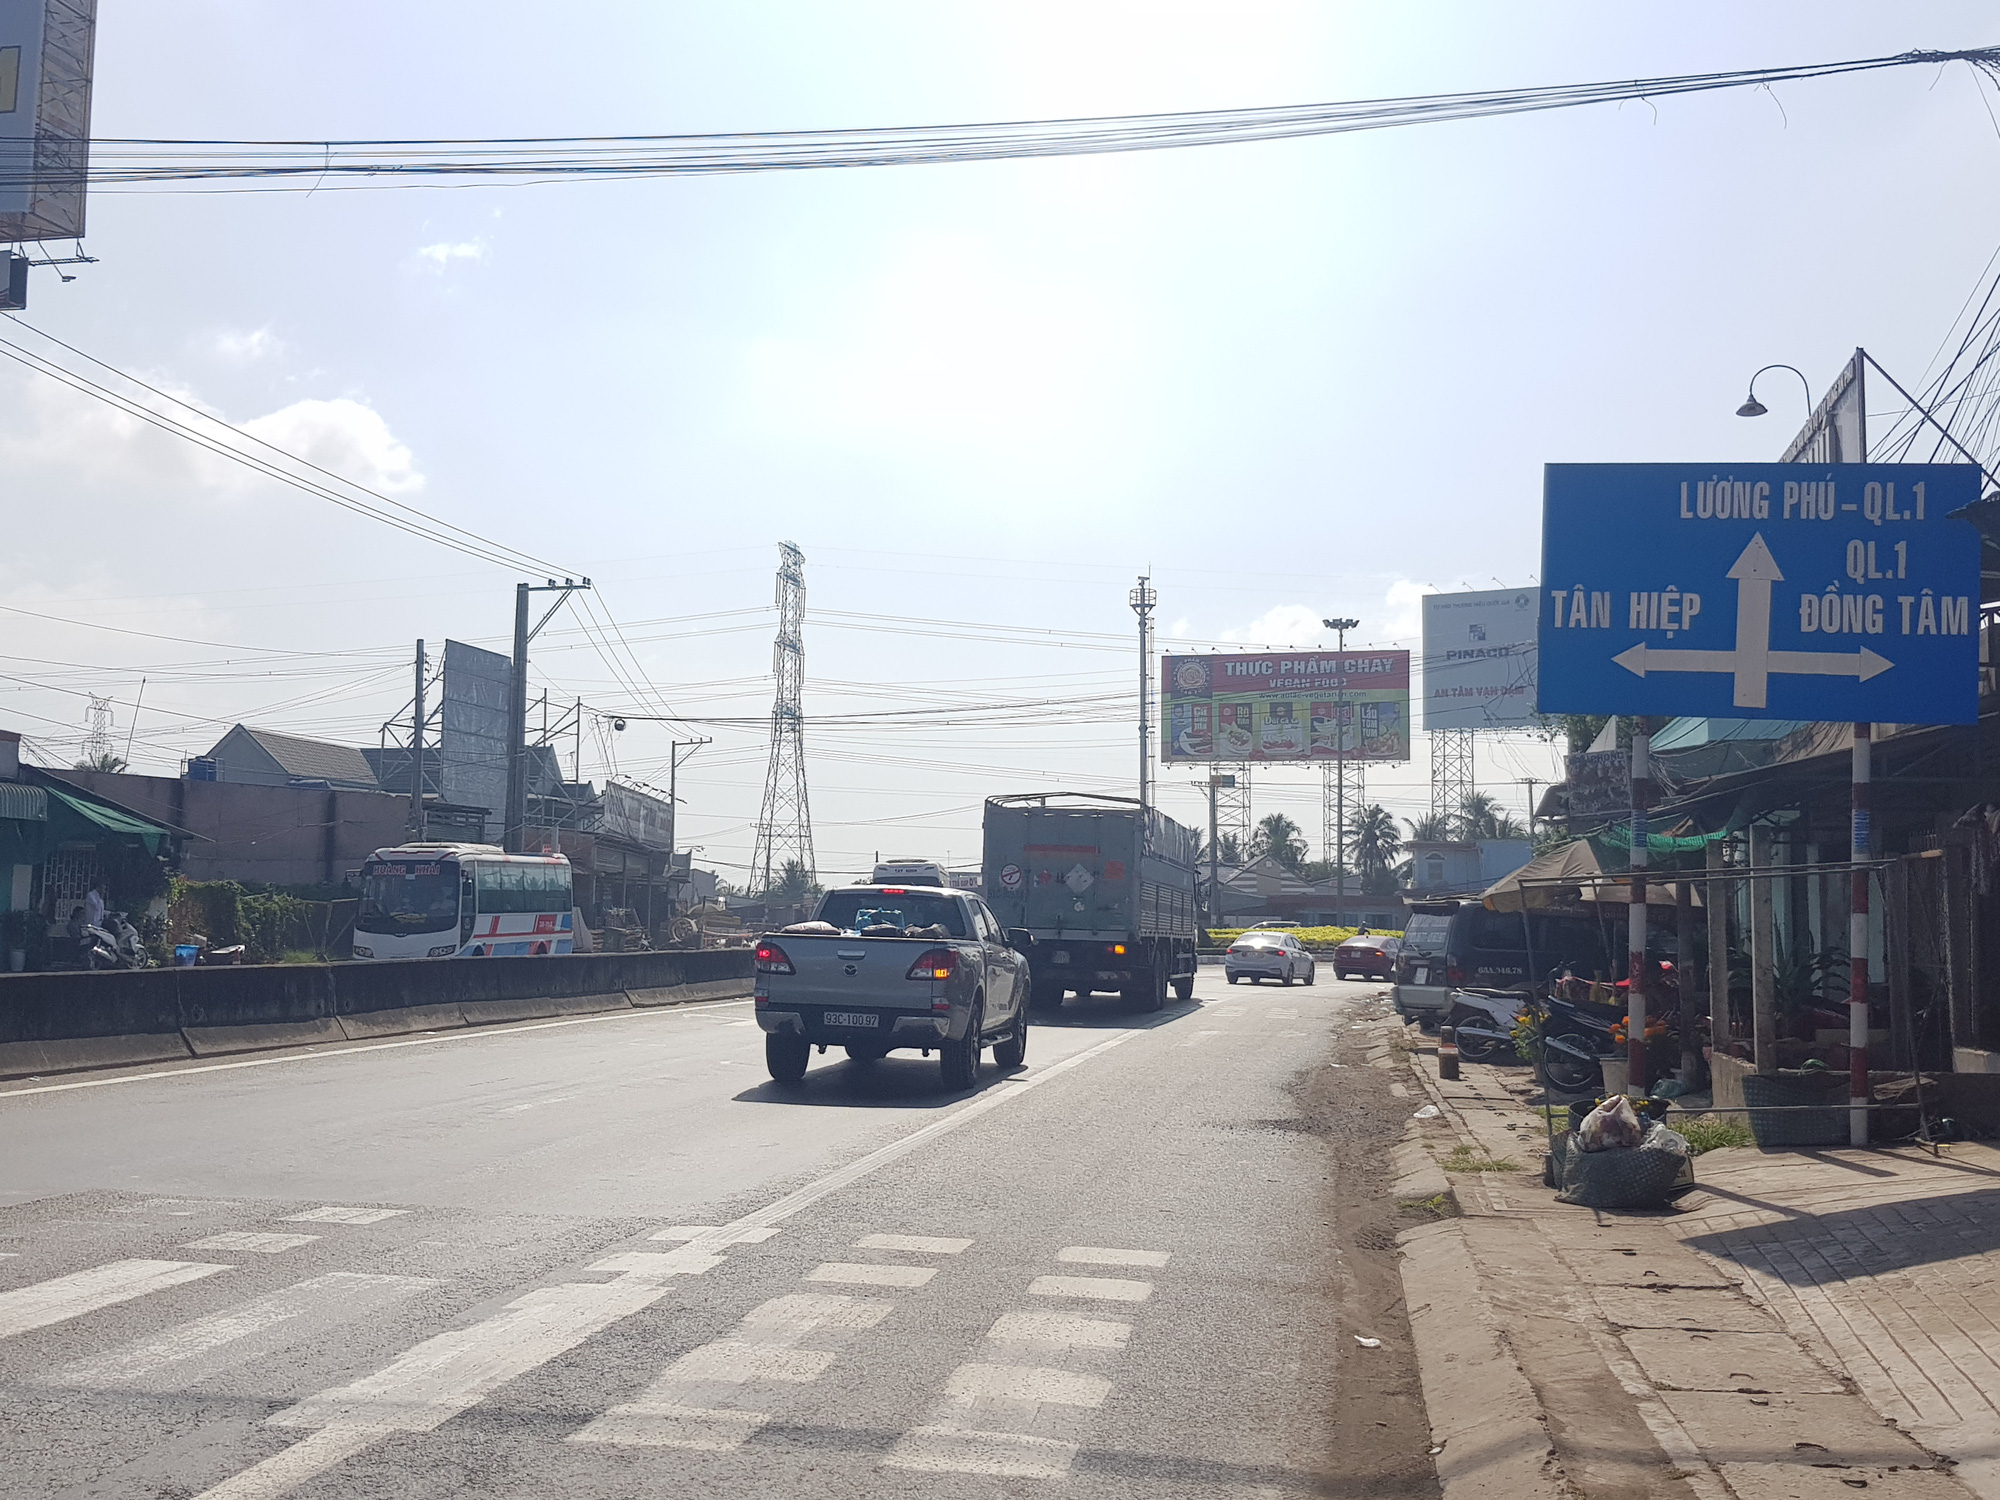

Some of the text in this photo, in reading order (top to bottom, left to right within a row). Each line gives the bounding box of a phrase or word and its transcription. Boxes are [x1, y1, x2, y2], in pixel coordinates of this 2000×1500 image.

[1680, 474, 1770, 520] LƯƠNG
[1783, 473, 1836, 521] PHÚ
[1864, 481, 1926, 526] QL.1
[1846, 539, 1907, 585] QL.1
[1551, 584, 1702, 639] TÂN HIỆP
[1798, 579, 1969, 636] ĐỒNG TÂM
[1445, 647, 1510, 660] PINACO
[1224, 655, 1395, 677] THỰC PHẨM CHAY
[1268, 677, 1311, 688] VEGAN
[1434, 688, 1449, 698] AN
[1452, 685, 1473, 698] TÂM
[372, 862, 407, 876] HOÀNG
[825, 1013, 877, 1026] 93C-100.97
